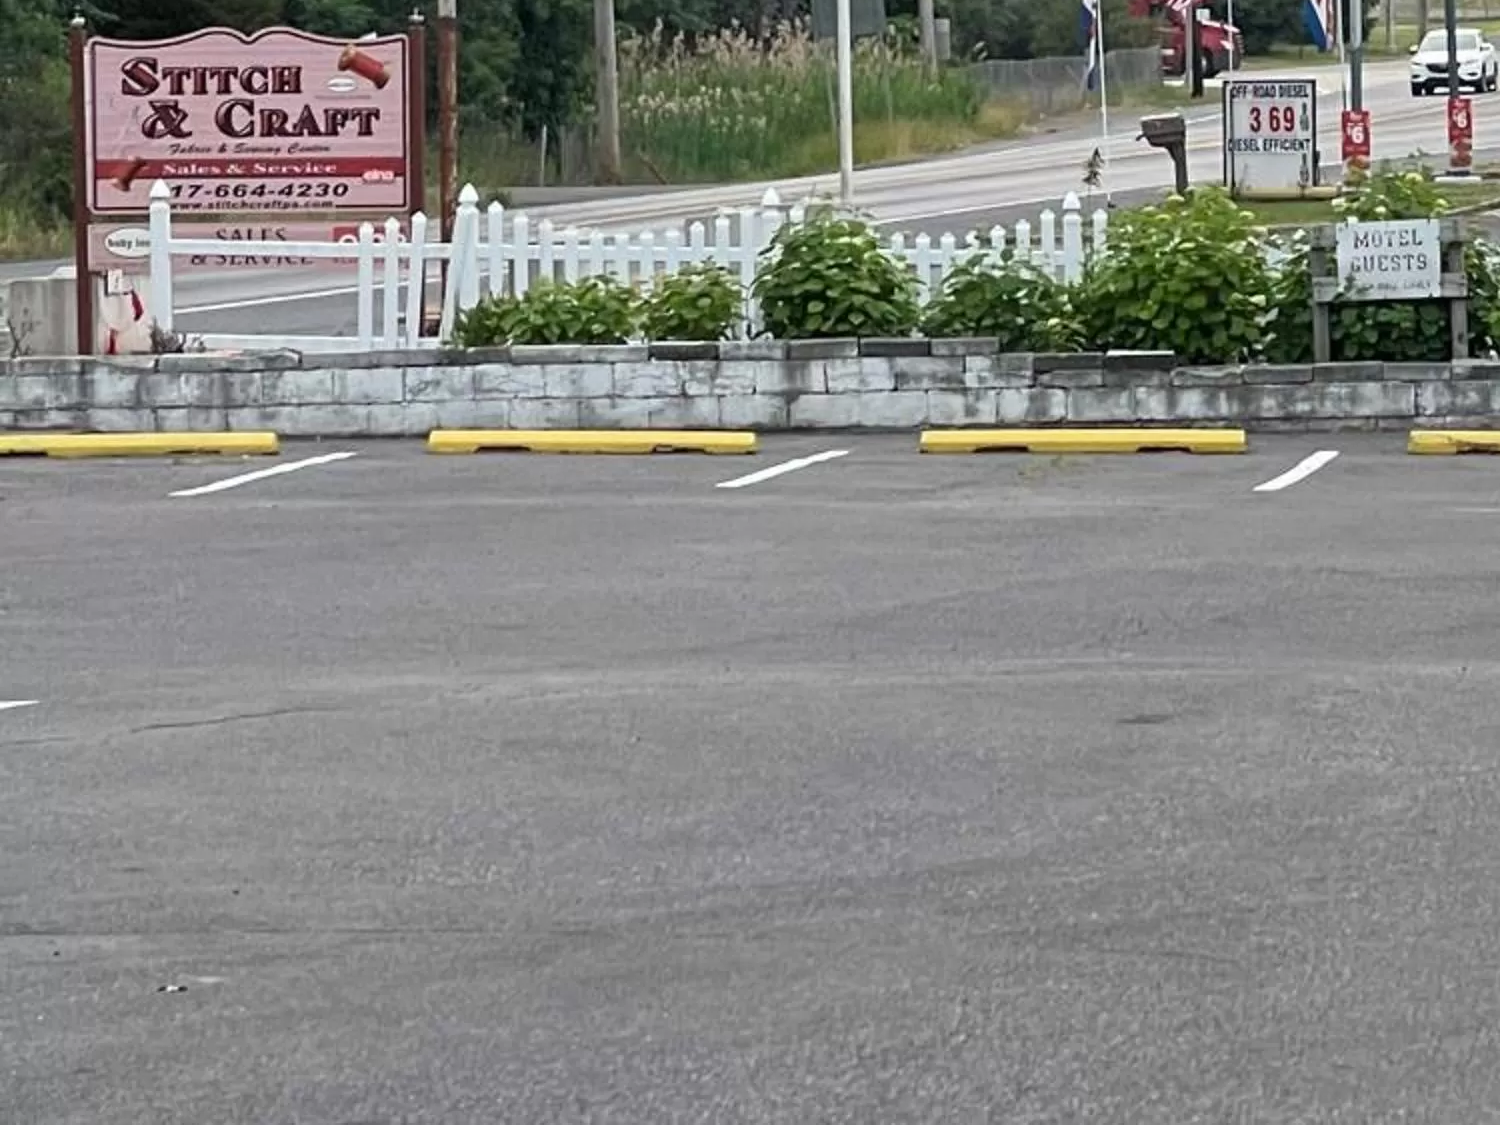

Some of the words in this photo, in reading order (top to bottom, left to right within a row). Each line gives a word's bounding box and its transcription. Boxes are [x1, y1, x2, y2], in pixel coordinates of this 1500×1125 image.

[121, 57, 303, 96] STITCH
[1278, 84, 1309, 98] DIESEL
[141, 99, 193, 139] &
[214, 98, 381, 138] CRAFT
[1228, 138, 1260, 152] DIESEL
[1262, 138, 1311, 152] EFFICIENT
[161, 162, 221, 175] Sales
[226, 163, 245, 175] &
[252, 161, 337, 175] Service
[169, 182, 349, 198] 17-664-4230
[1353, 228, 1423, 249] MOTEL
[1350, 253, 1428, 273] GUESTS
